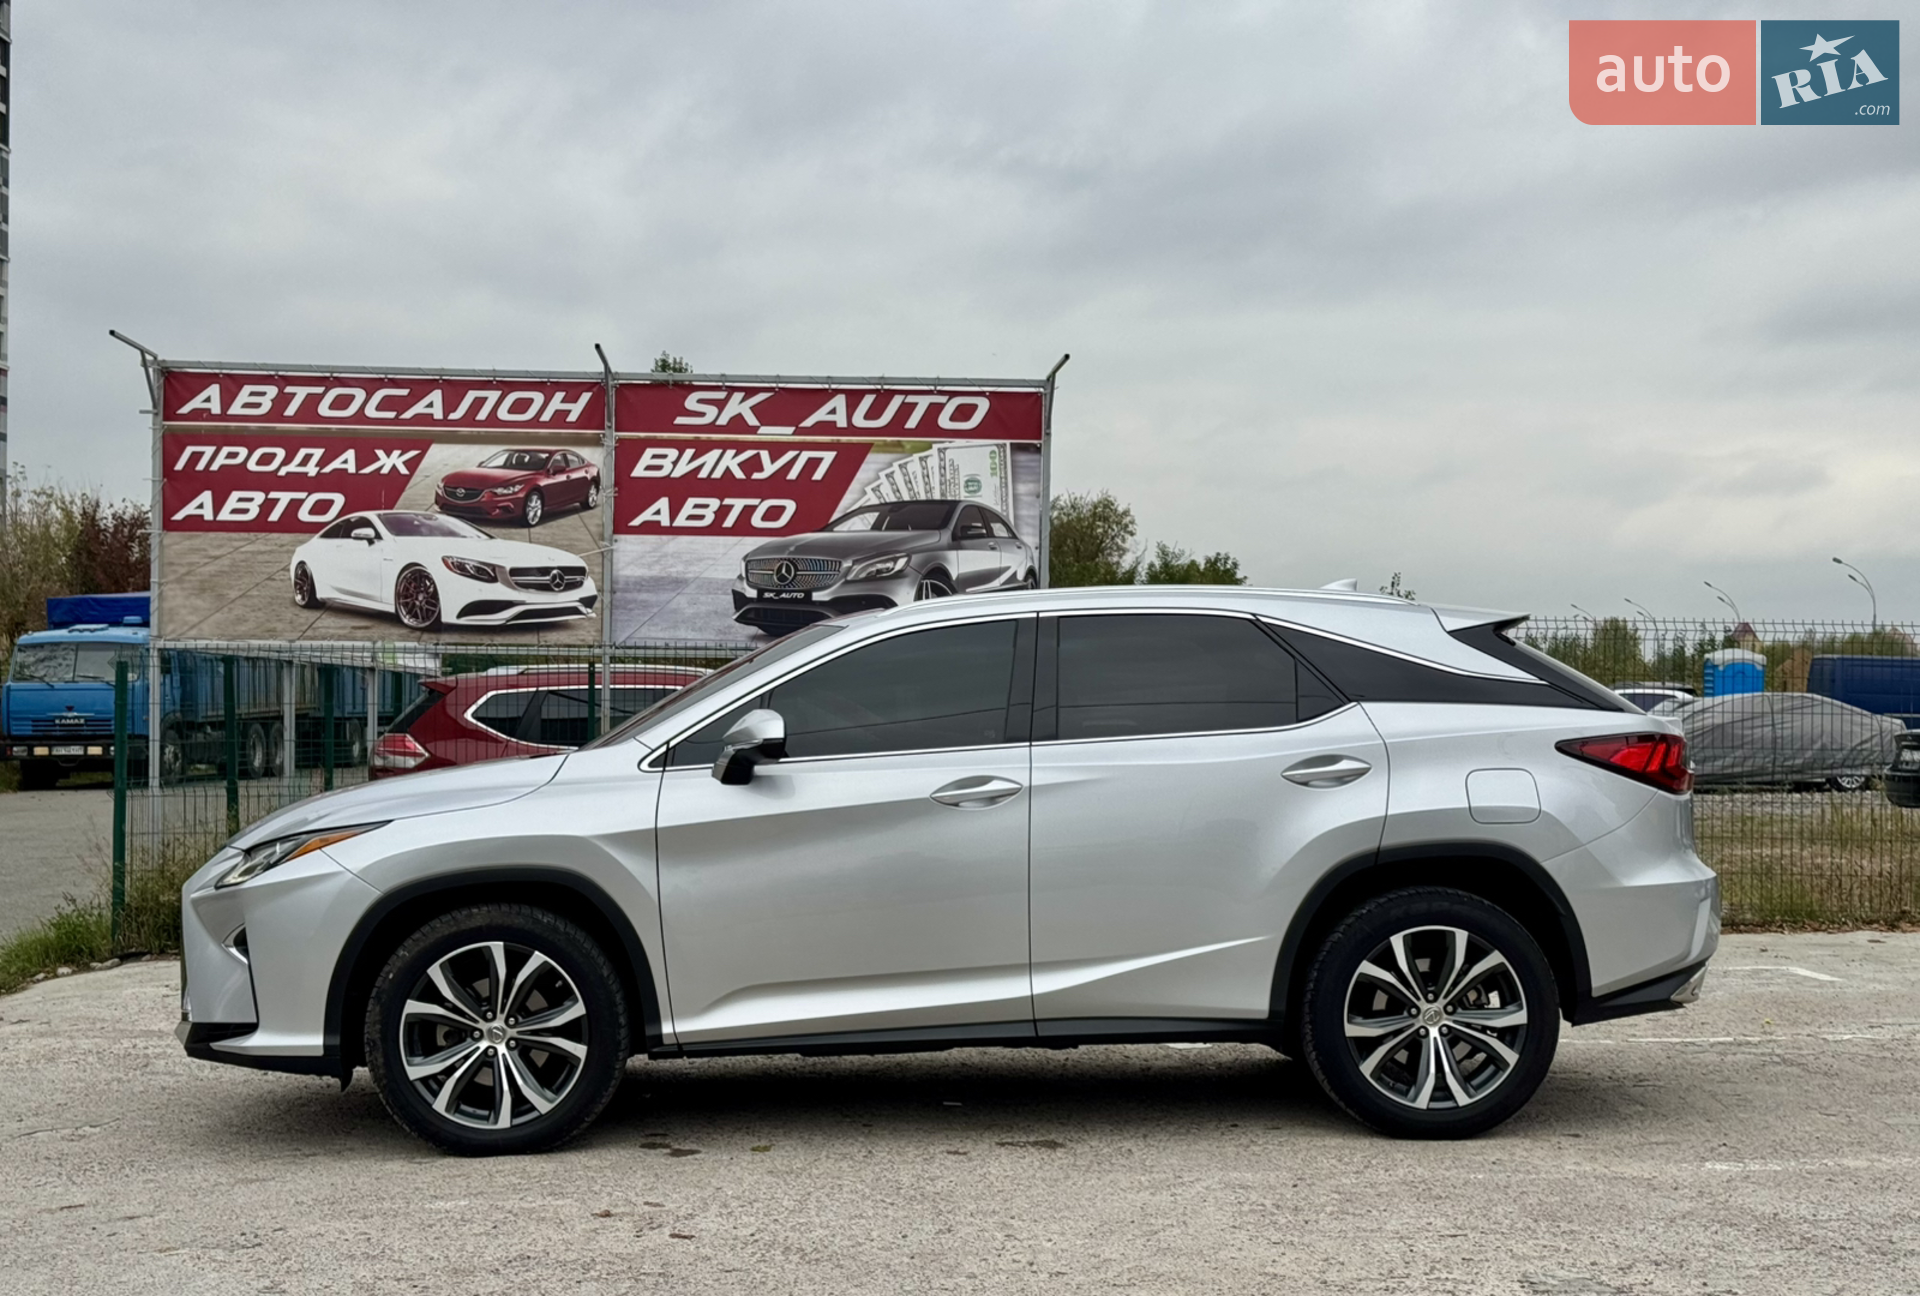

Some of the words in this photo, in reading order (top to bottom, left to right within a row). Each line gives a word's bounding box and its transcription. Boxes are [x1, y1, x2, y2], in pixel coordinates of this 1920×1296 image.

[176, 383, 593, 422] АВТОСАЛОН
[673, 390, 990, 436] SK_AUTO
[173, 445, 422, 477] ПРОДАЖ
[630, 447, 838, 481] ВИКУП
[170, 490, 346, 523] АВТО
[628, 496, 797, 529] АВТО
